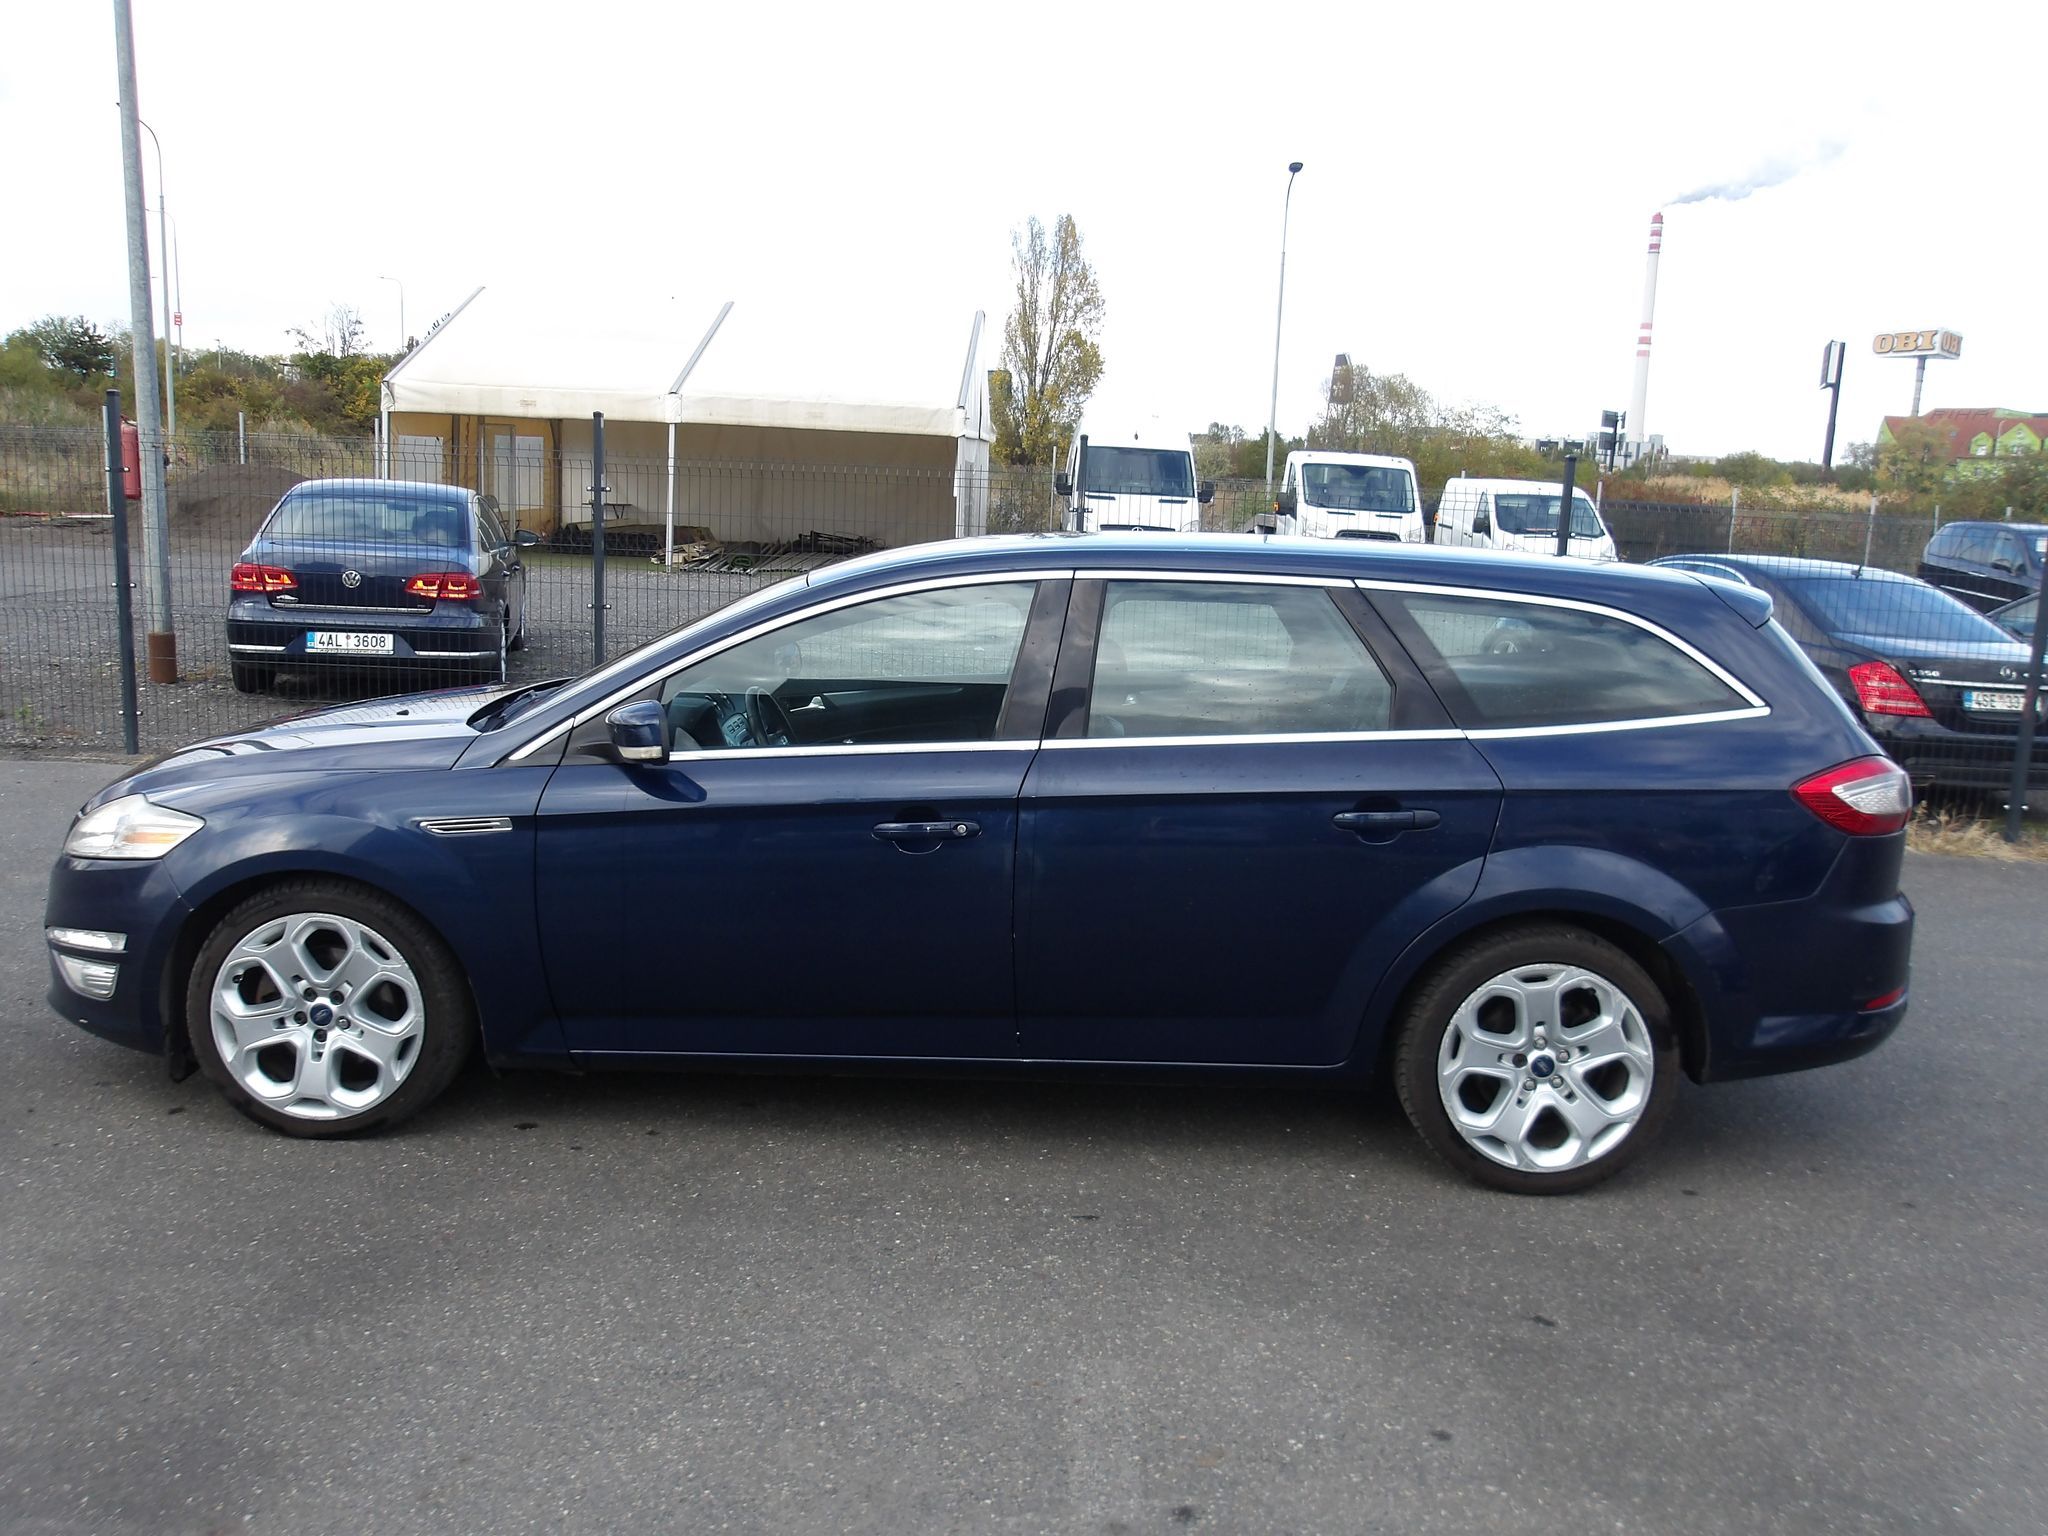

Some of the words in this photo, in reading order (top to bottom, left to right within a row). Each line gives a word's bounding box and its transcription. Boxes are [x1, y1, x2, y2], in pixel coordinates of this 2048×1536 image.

[1873, 330, 1938, 353] OBI
[318, 634, 342, 647] 4AL
[353, 635, 386, 648] 3608
